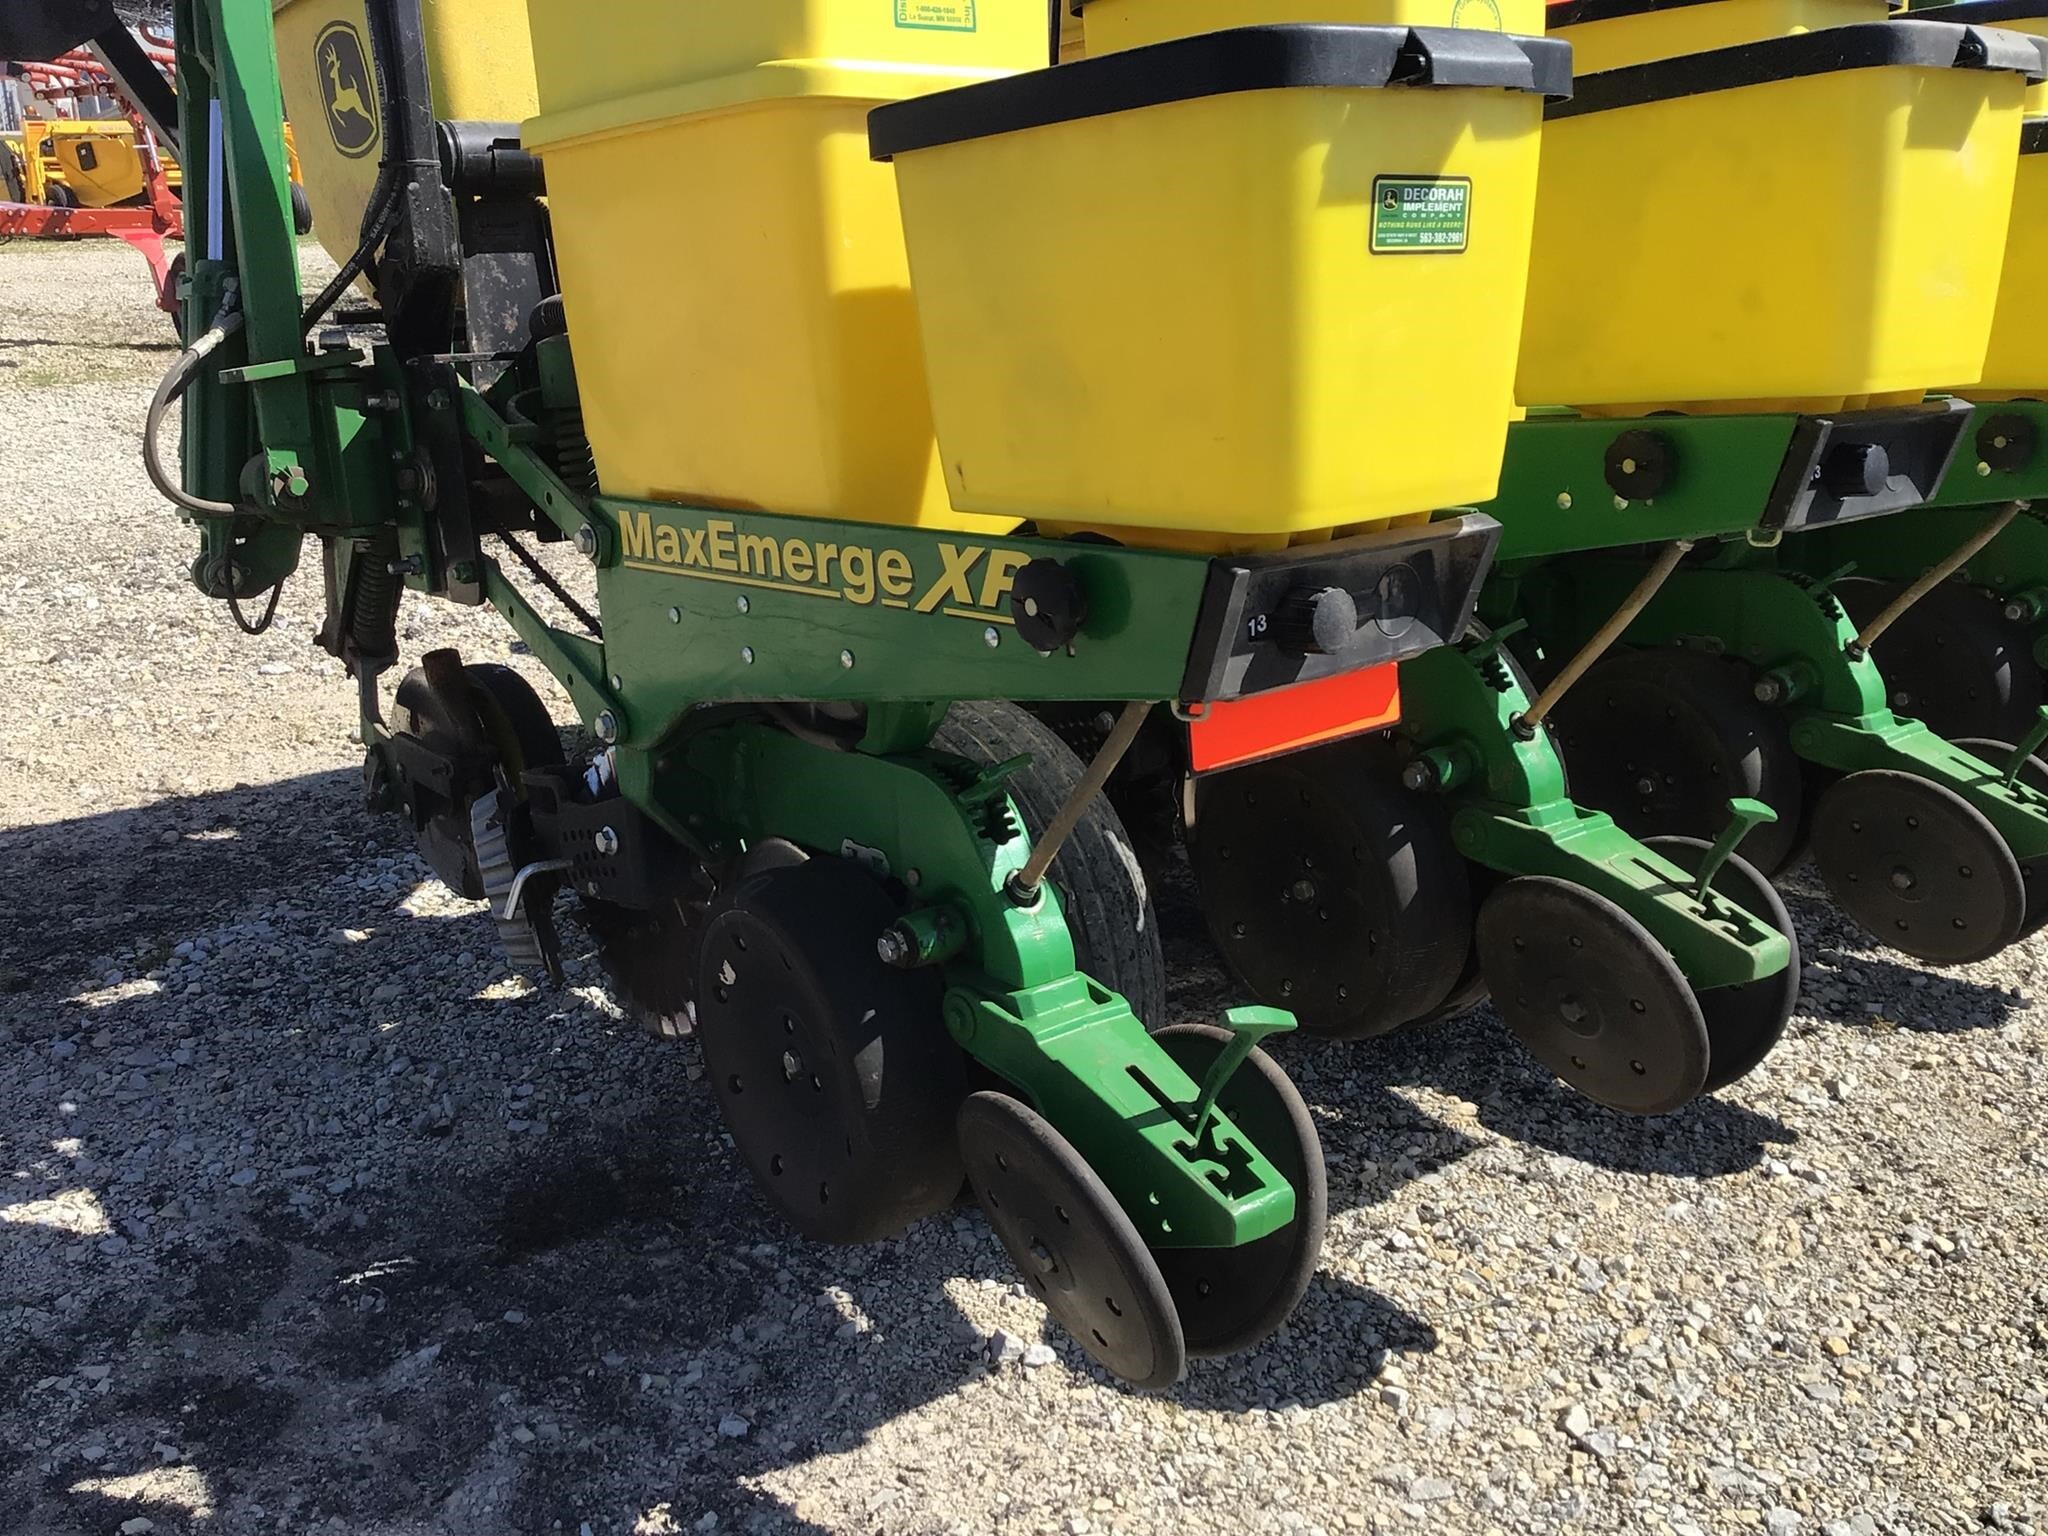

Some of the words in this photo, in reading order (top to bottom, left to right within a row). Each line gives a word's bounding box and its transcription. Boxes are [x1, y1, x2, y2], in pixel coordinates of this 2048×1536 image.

[1403, 188, 1464, 201] DECORAH
[1403, 203, 1462, 212] IMPLEMENT
[618, 510, 914, 605] MaxEmerge
[914, 543, 1032, 613] XP
[1248, 614, 1267, 636] 13
